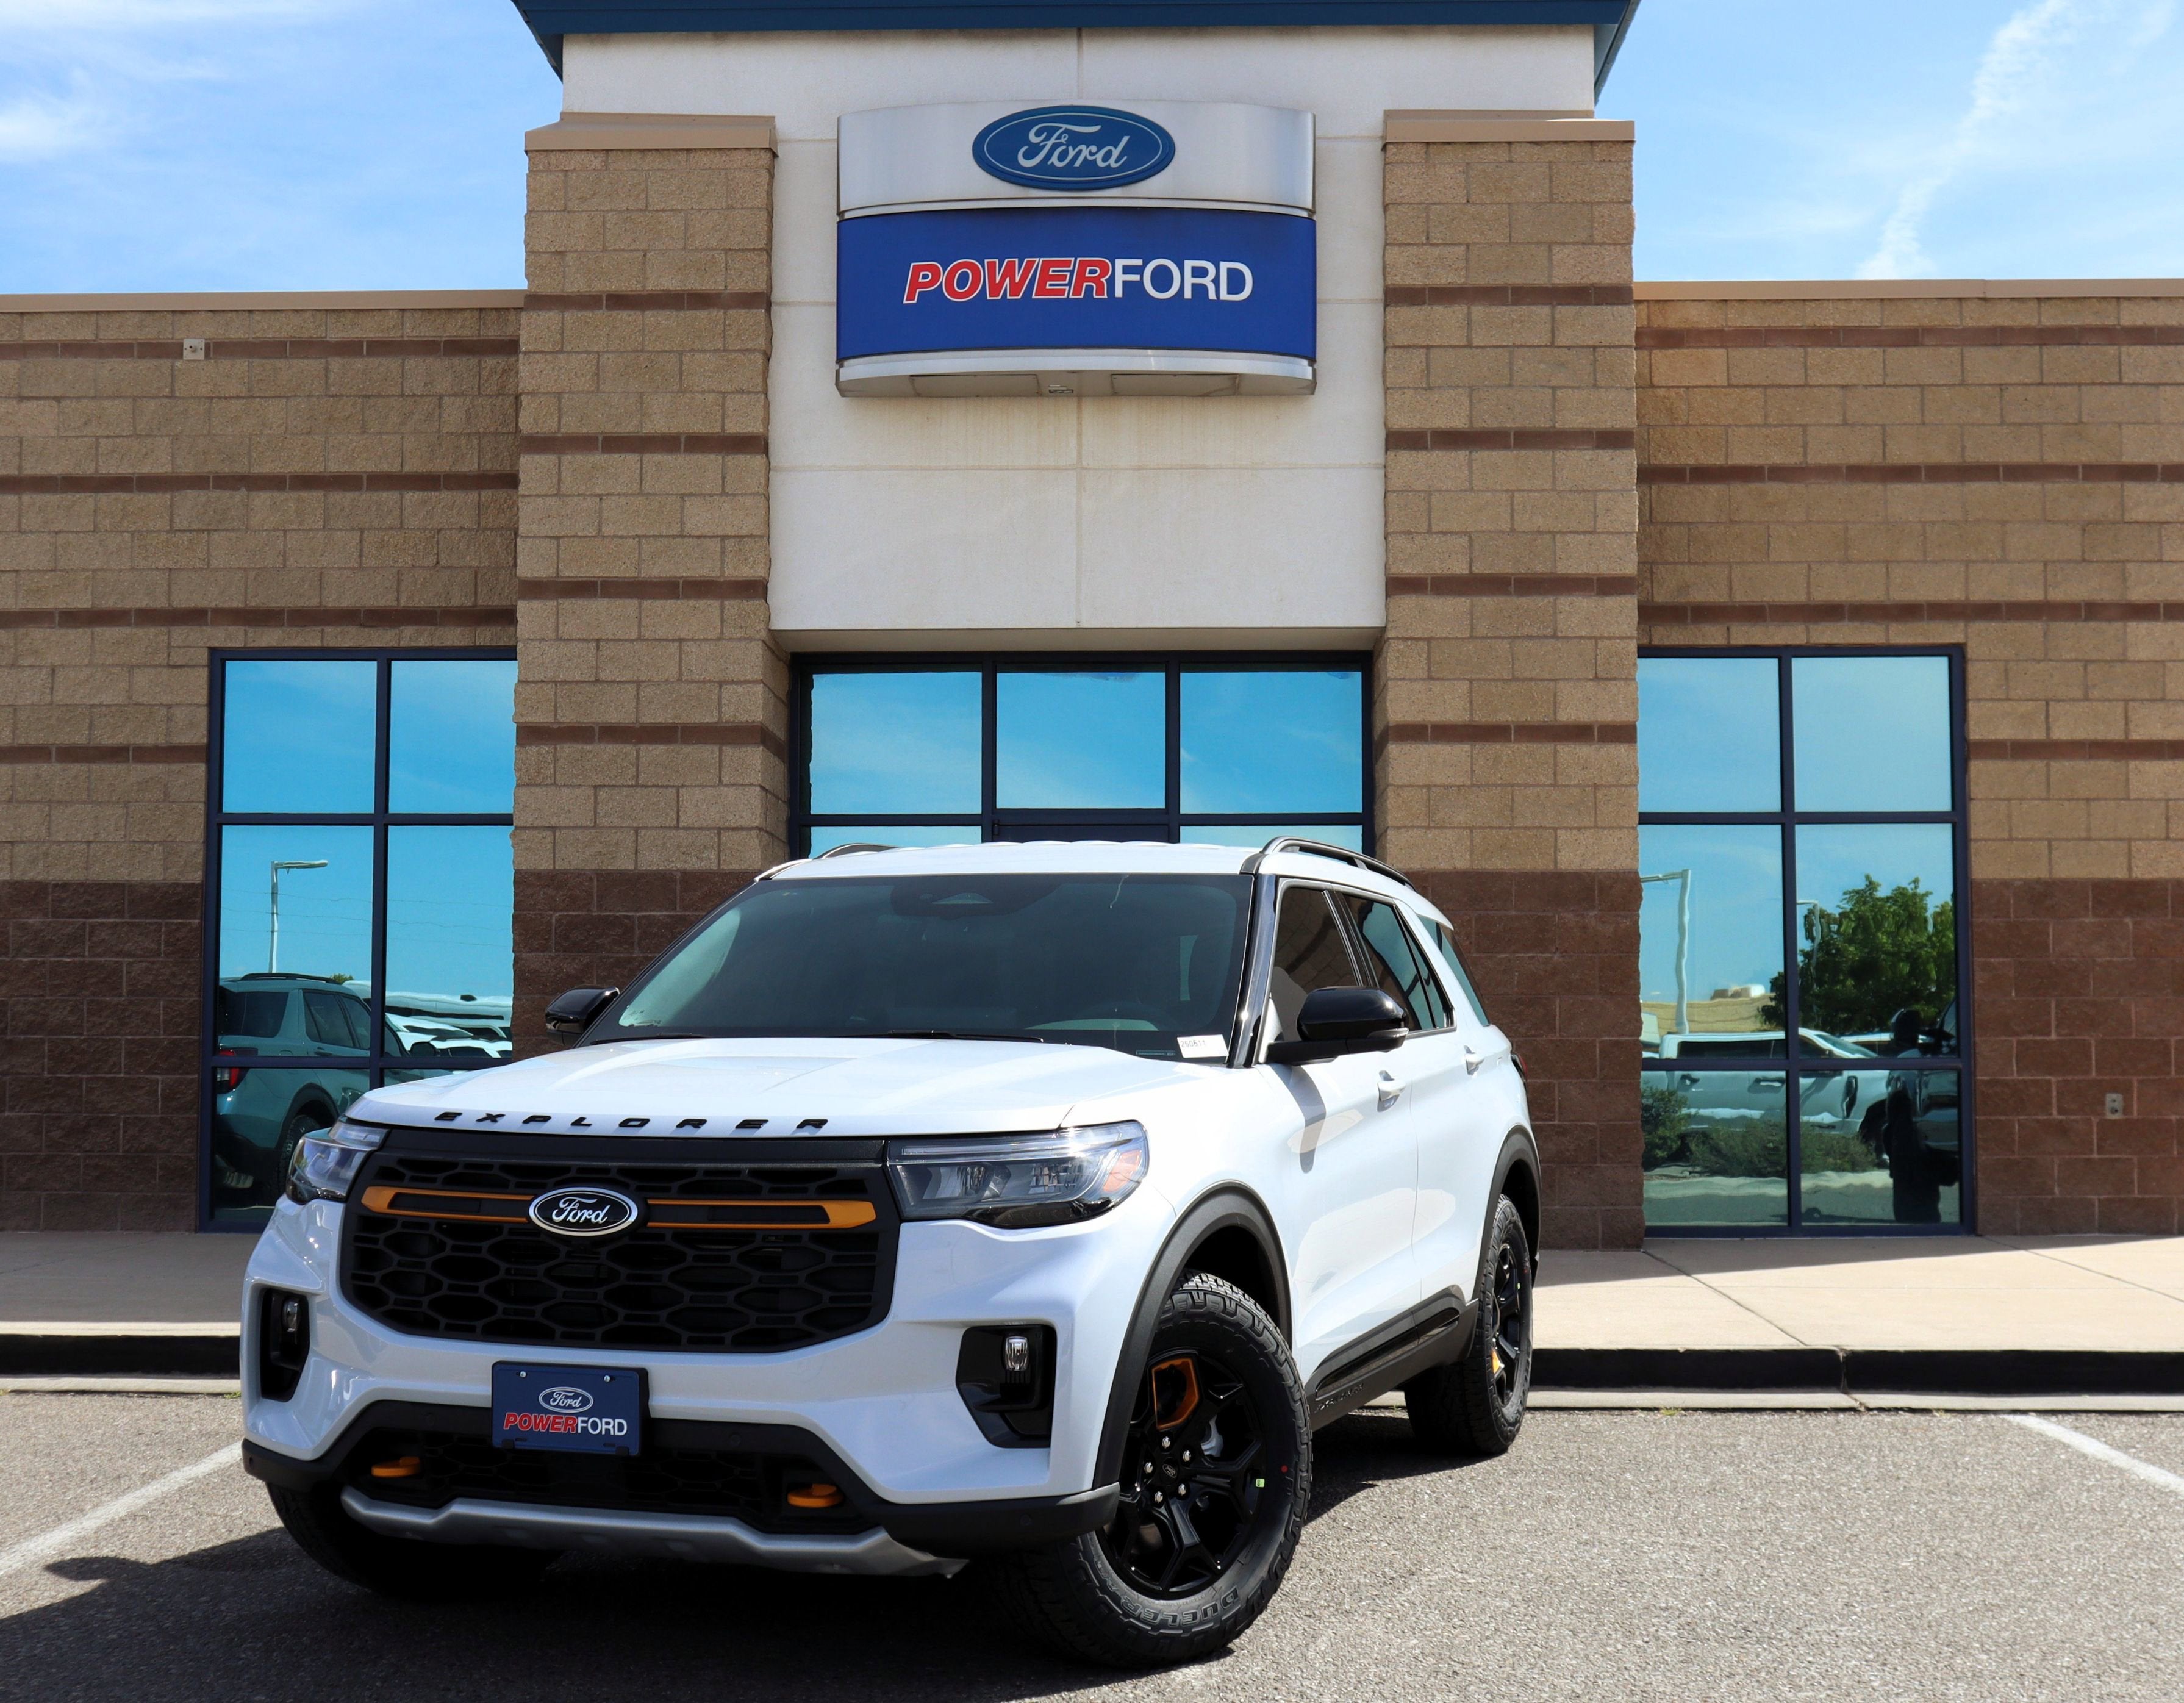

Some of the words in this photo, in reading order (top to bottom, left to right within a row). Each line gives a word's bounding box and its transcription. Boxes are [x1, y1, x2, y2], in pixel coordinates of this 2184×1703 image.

[1017, 123, 1129, 169] Ford
[434, 1112, 828, 1130] EXPLORER
[551, 1196, 609, 1224] Ford
[550, 1391, 582, 1408] Ford
[1120, 1585, 1239, 1627] DUELER
